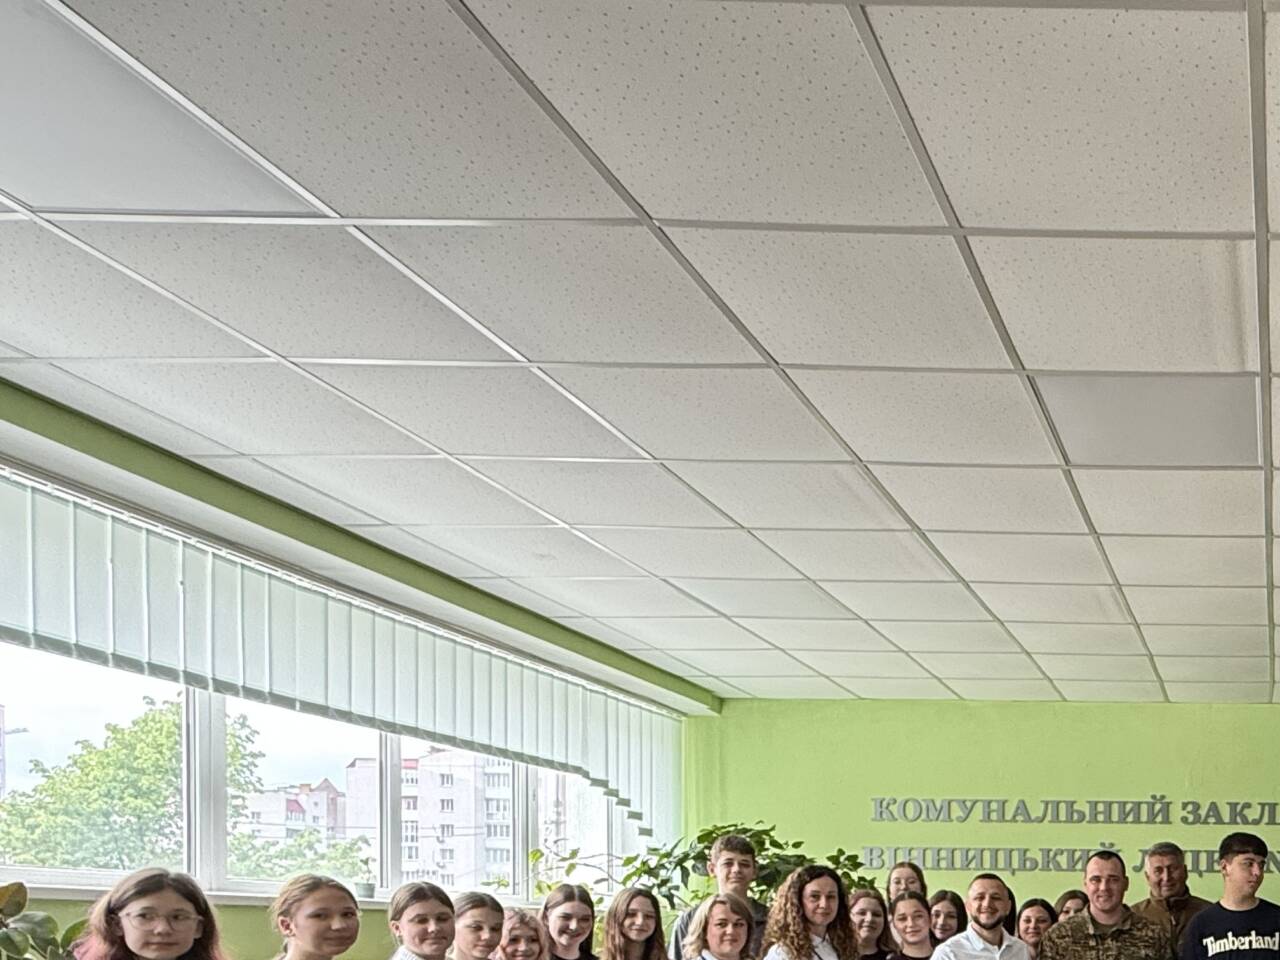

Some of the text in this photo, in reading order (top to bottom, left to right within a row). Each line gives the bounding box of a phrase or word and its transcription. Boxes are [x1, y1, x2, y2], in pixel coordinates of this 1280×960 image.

[871, 795, 1173, 825] КОМУНАЛЬНИЙ
[862, 841, 1122, 876] ВІННИЦЬКИ
[1202, 930, 1280, 957] Timberland
